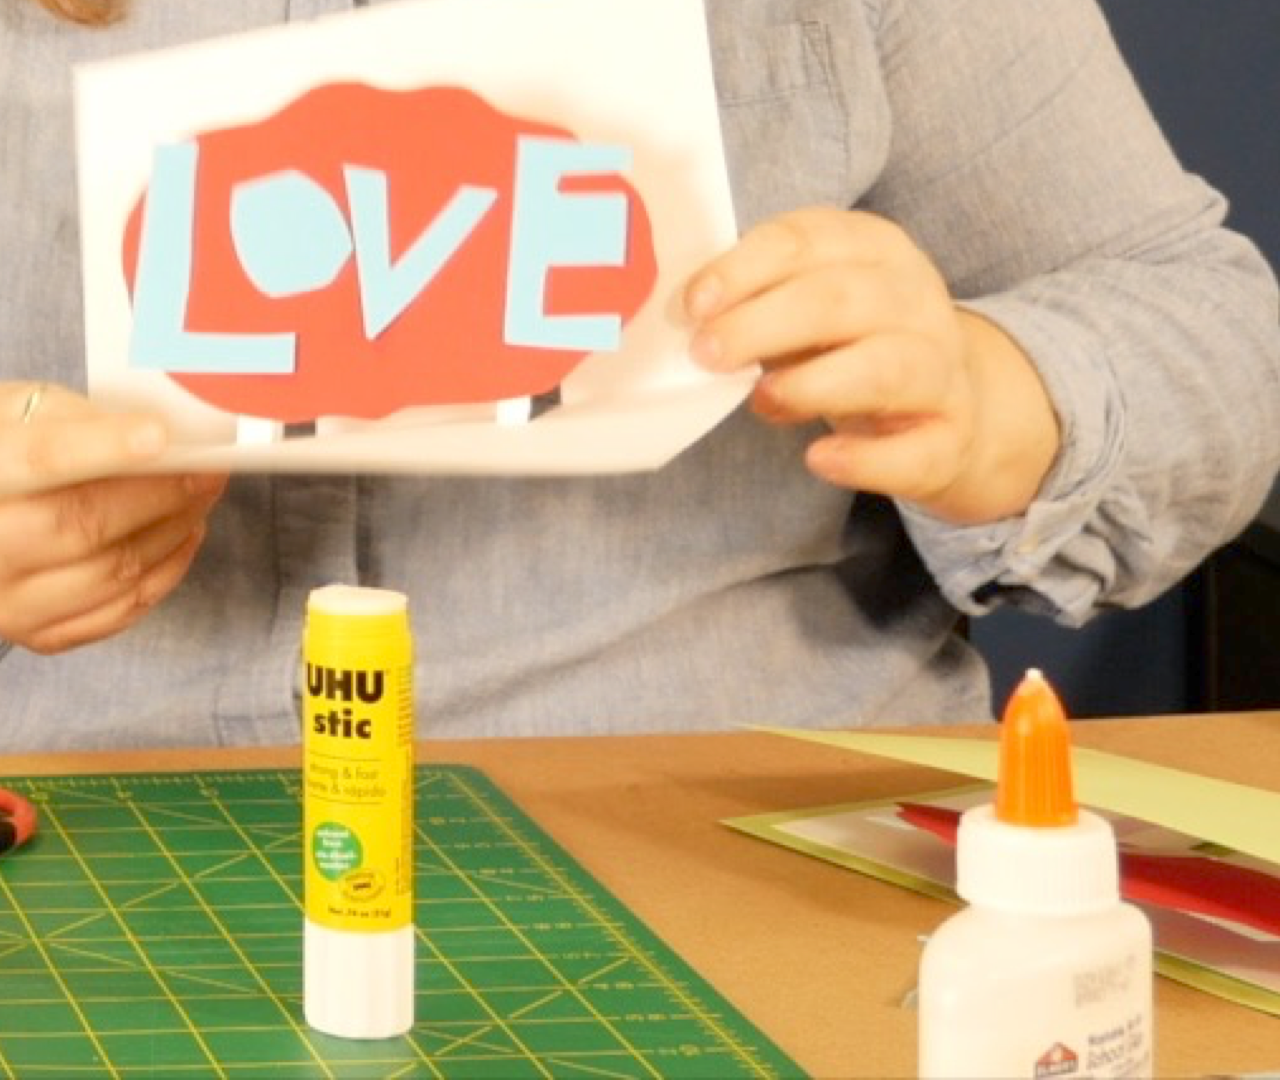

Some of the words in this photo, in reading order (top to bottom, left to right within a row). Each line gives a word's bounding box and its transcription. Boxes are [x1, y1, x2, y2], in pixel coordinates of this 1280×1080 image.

[129, 134, 633, 374] LOVE
[307, 663, 384, 704] UHU
[313, 708, 372, 740] stic
